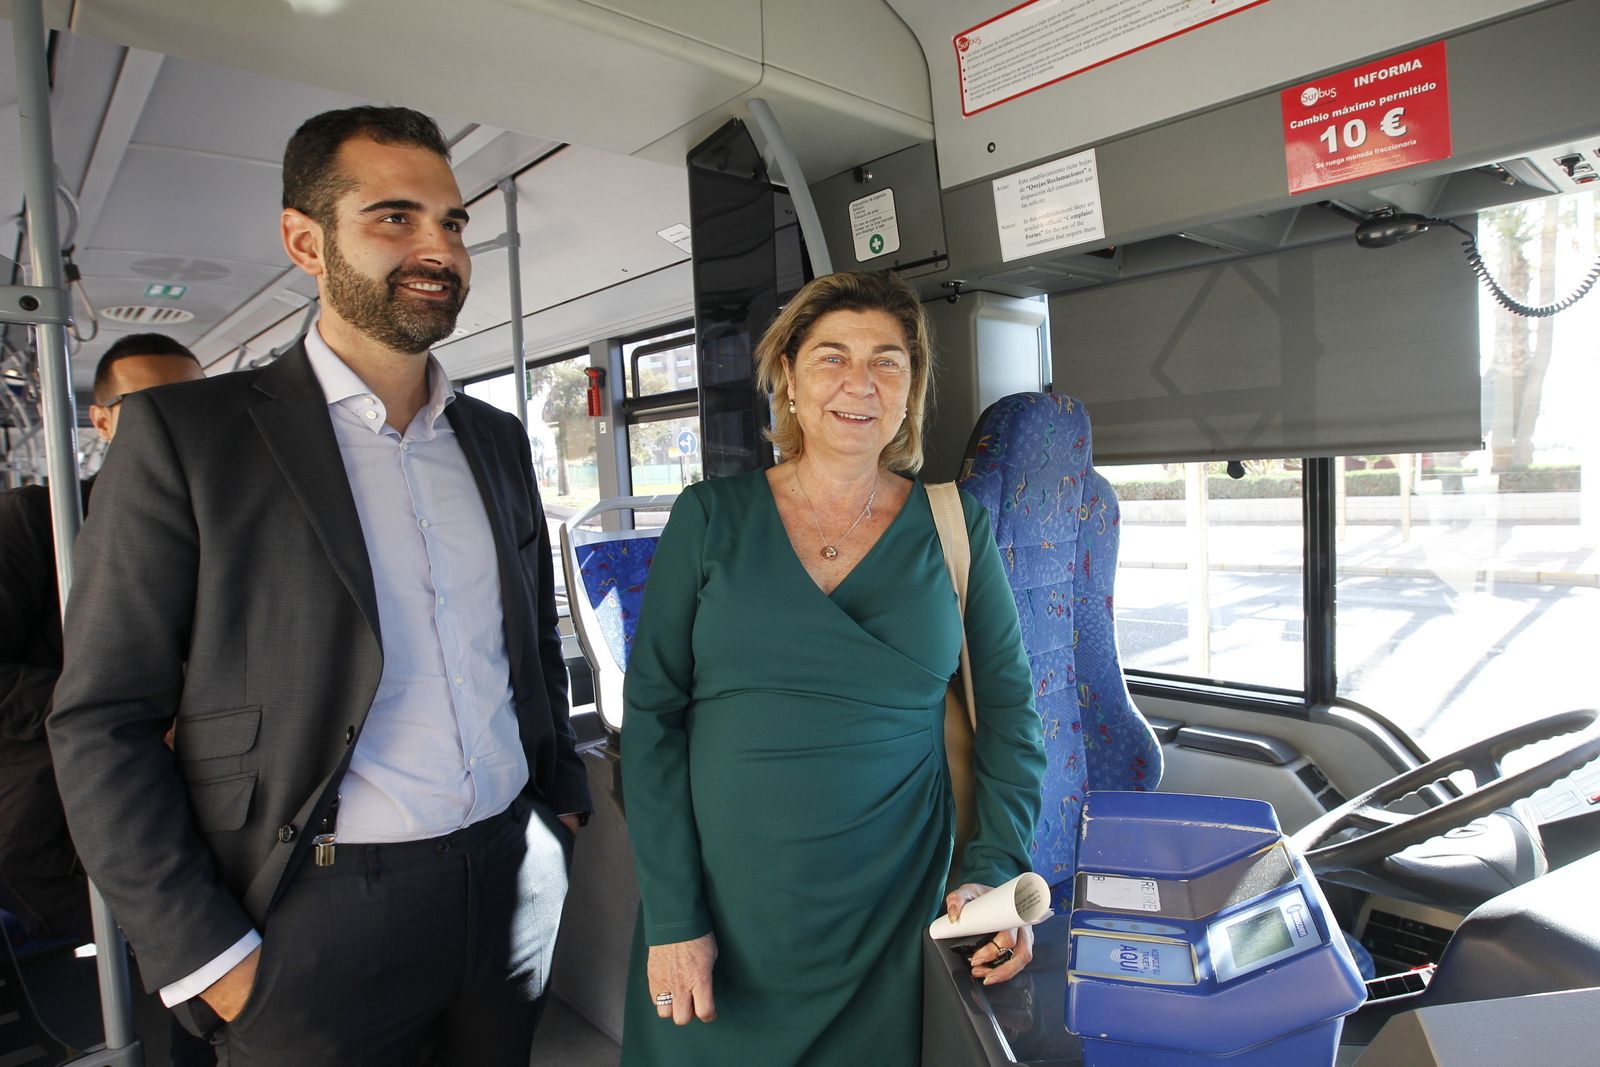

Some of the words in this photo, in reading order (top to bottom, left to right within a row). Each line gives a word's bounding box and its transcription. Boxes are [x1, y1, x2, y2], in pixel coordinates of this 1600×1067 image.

[1354, 58, 1423, 88] INFORMA
[1290, 112, 1330, 129] Cambio
[1332, 100, 1376, 118] máximo
[1379, 81, 1436, 106] permitido
[1301, 87, 1337, 104] Surbus
[1320, 118, 1367, 154] 10
[1380, 106, 1407, 137] €
[1316, 161, 1325, 169] Se
[1326, 157, 1345, 167] ruega
[1346, 150, 1373, 162] moneda
[1374, 139, 1417, 155] fraccionaria
[1141, 881, 1157, 910] RETIRE
